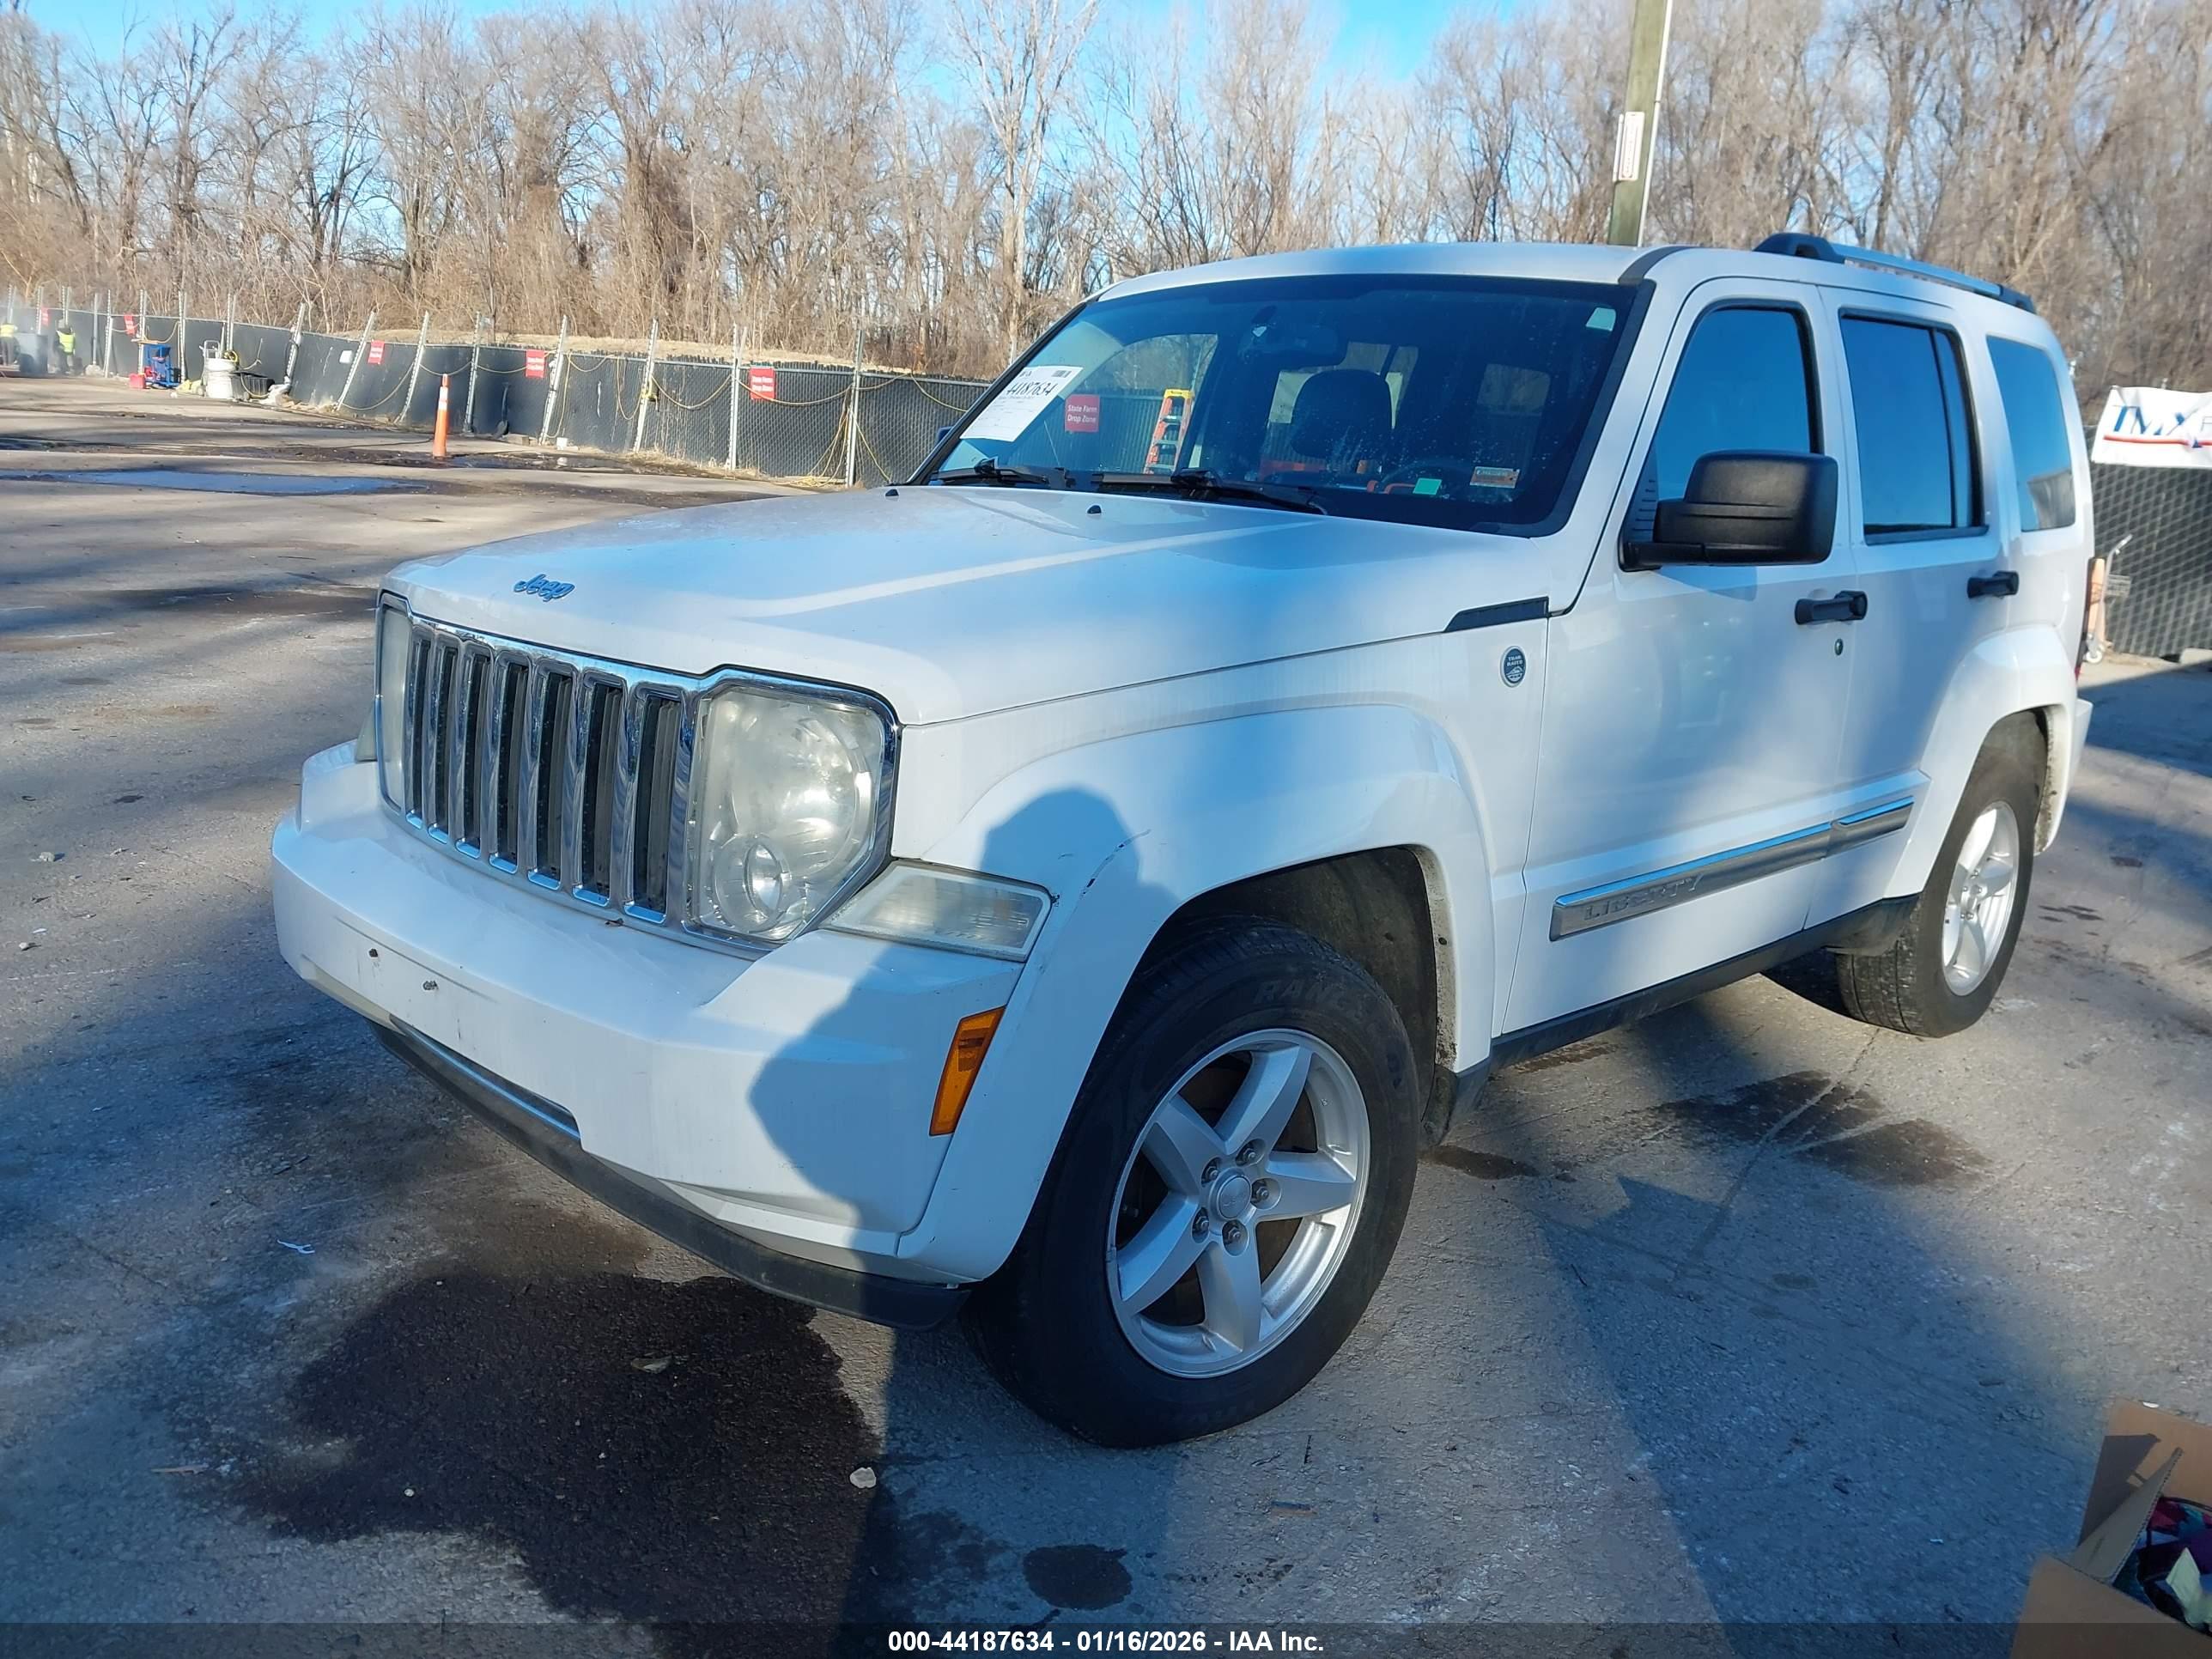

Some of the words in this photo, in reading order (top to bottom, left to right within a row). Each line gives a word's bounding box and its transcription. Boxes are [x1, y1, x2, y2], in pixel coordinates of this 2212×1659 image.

[1006, 380, 1058, 397] 44187634
[1067, 414, 1081, 423] Drop
[514, 574, 576, 603] Jeep
[1583, 873, 1705, 921] LIBERTY
